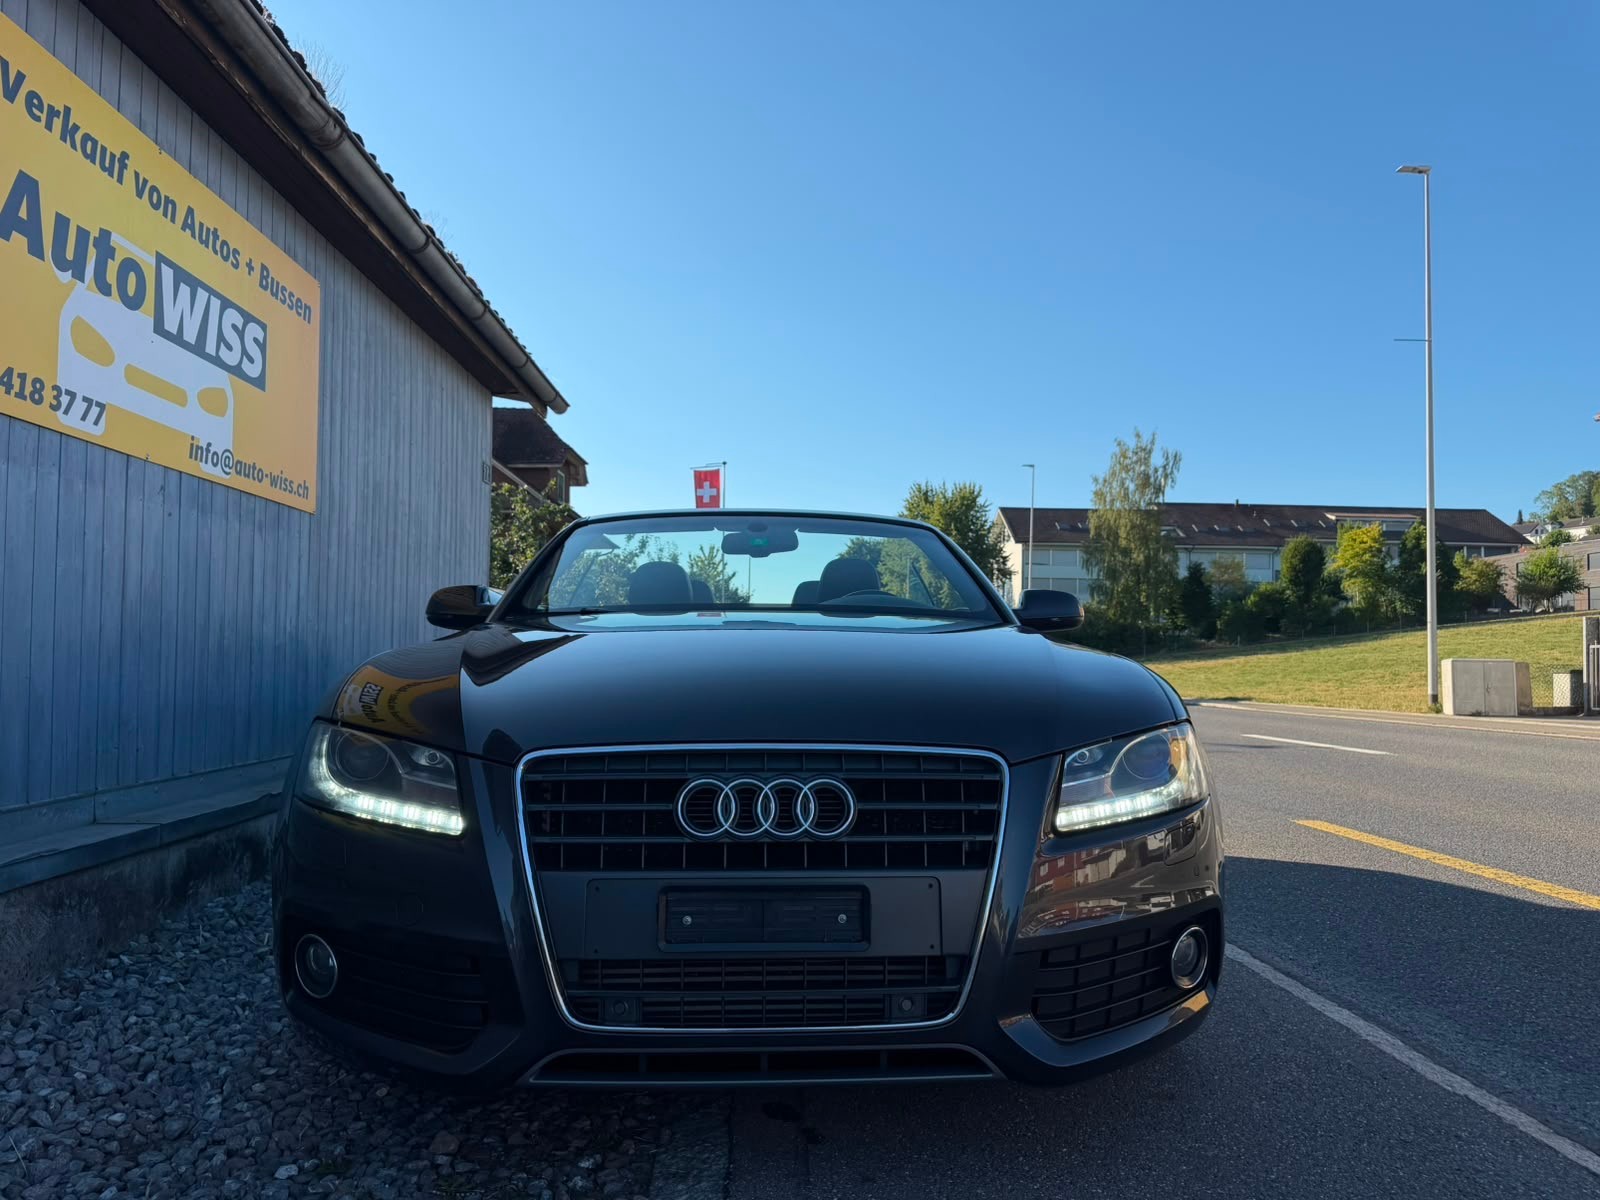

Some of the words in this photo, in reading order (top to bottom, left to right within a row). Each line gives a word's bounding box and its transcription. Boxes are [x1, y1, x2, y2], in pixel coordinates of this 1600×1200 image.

[0, 55, 130, 186] Verkauf
[134, 169, 177, 224] von
[181, 205, 241, 270] Autos
[258, 262, 312, 324] Bussen
[0, 168, 147, 311] Auto
[160, 262, 265, 379] WISS
[0, 366, 45, 406] 418
[49, 384, 77, 416] 37
[80, 395, 107, 427] 77
[188, 436, 310, 500] info@auto-wiss.ch
